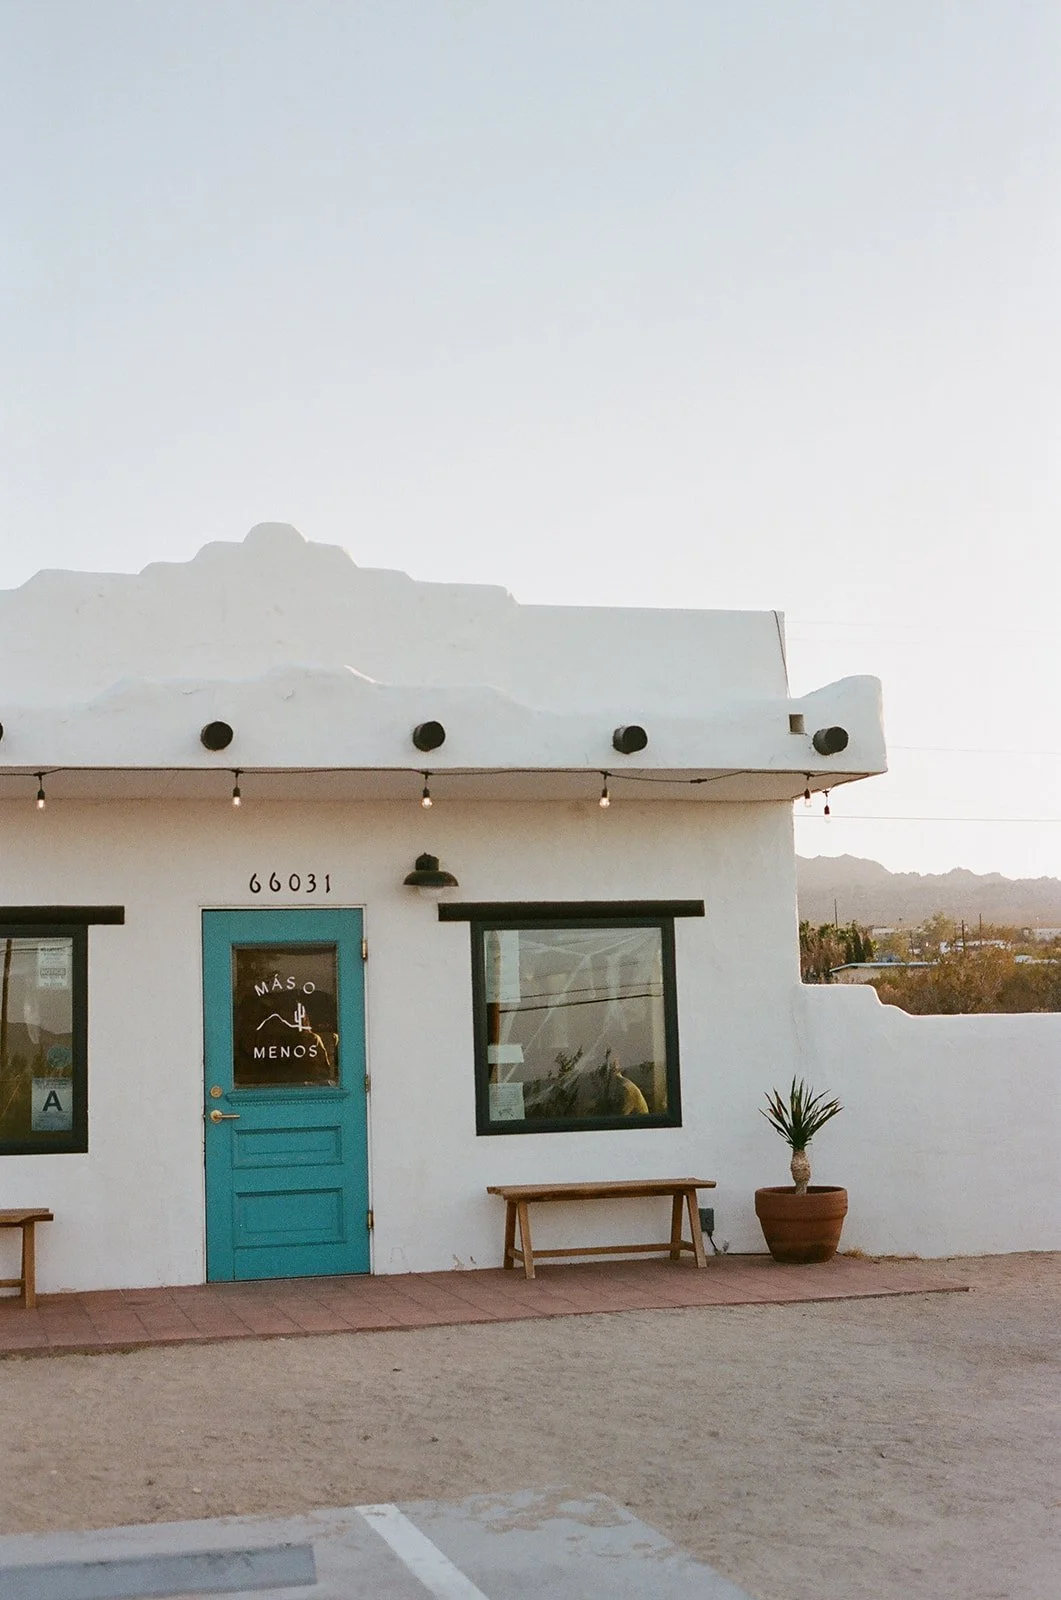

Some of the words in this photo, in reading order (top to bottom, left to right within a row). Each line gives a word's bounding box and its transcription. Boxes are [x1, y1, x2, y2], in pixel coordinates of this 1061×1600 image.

[249, 871, 332, 894] 66031
[254, 973, 296, 997] MÁS
[303, 981, 316, 995] O
[253, 1045, 318, 1059] MENOS
[42, 1090, 63, 1112] A
